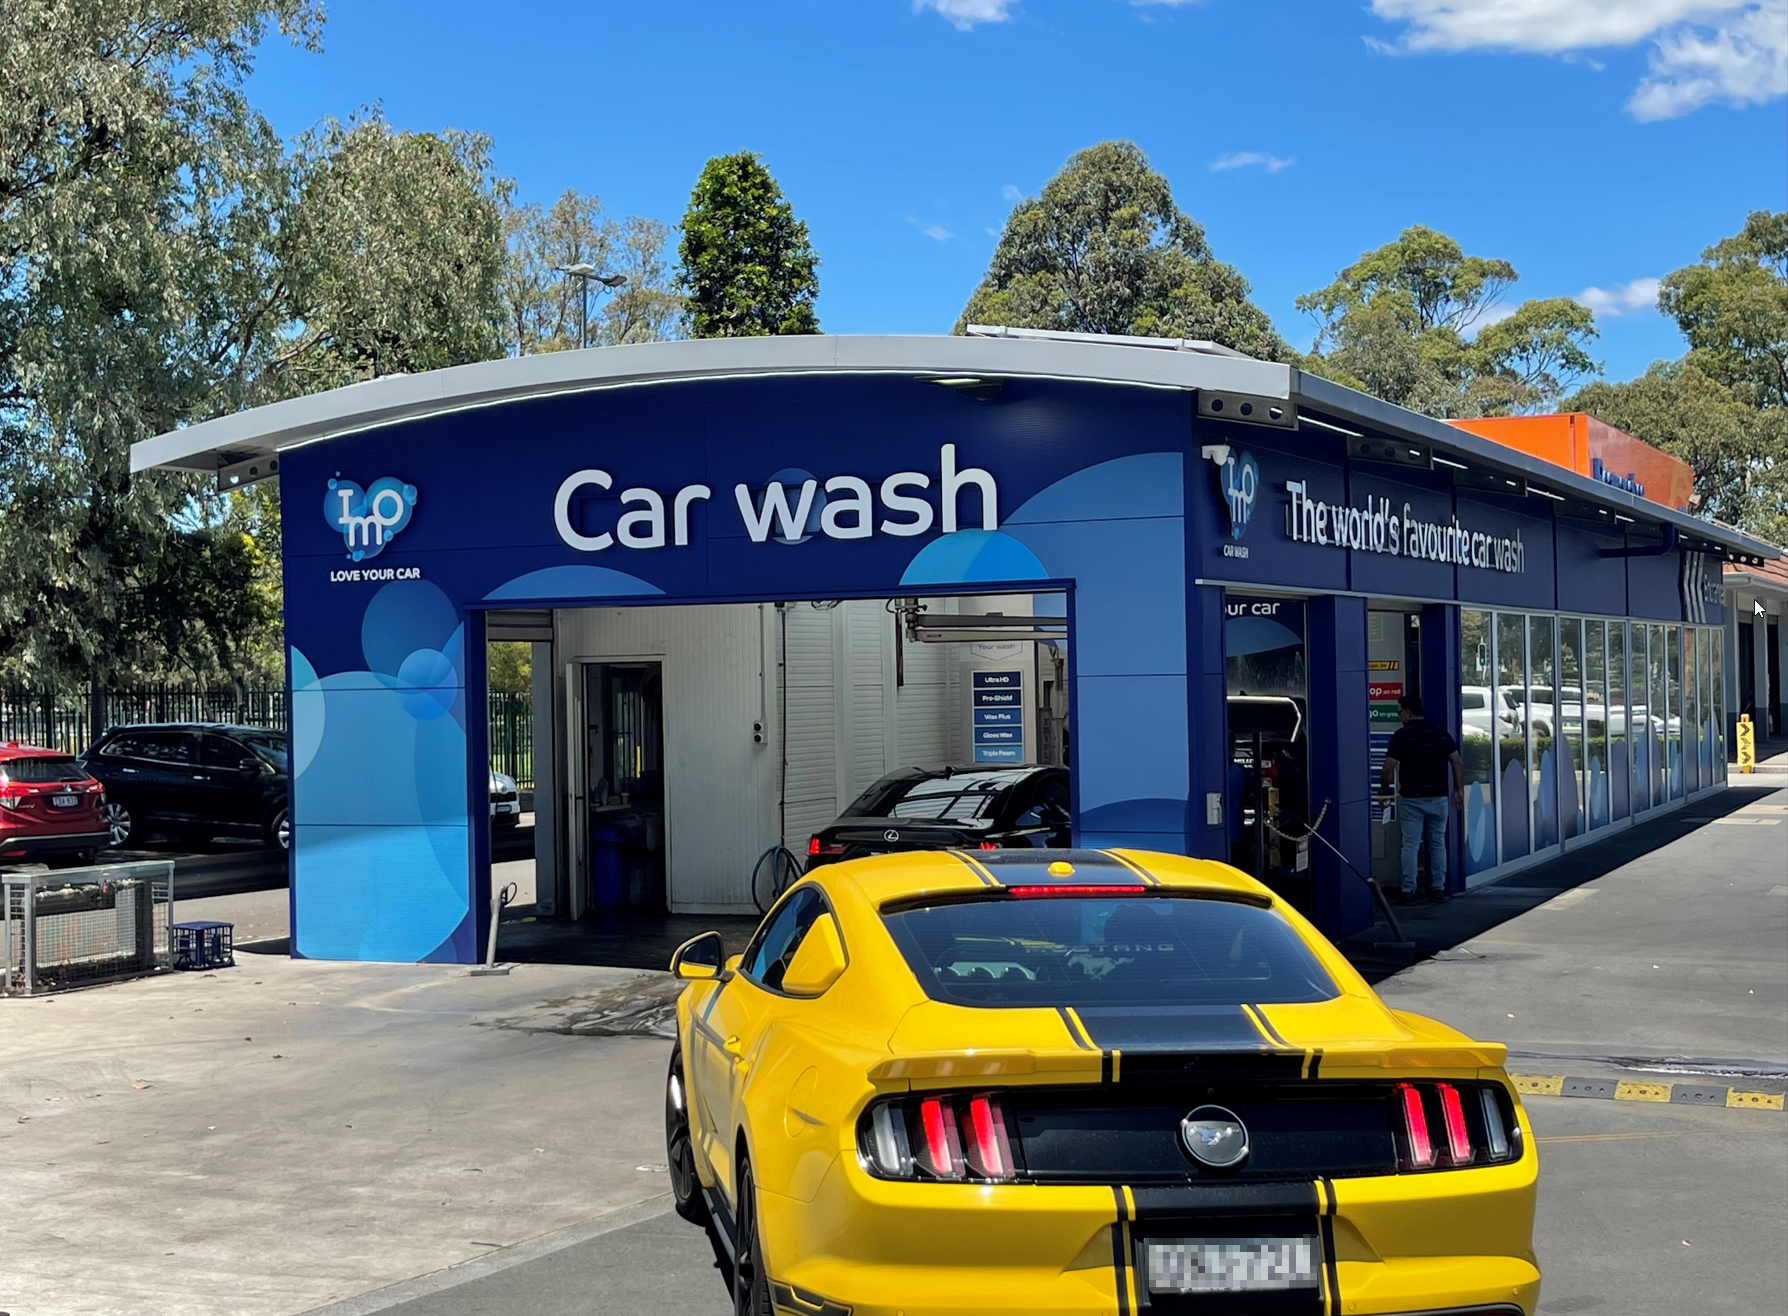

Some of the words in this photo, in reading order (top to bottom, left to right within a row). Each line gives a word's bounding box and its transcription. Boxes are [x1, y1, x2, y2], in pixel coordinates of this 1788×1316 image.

[553, 469, 711, 552] Car
[734, 443, 998, 543] wash
[1286, 478, 1328, 546] The
[1331, 493, 1400, 556] world's
[1402, 501, 1470, 567] favourite
[1471, 530, 1495, 569] car
[1494, 527, 1525, 574] wash
[1223, 544, 1234, 557] CAR
[330, 570, 360, 582] LOVE
[361, 568, 395, 581] YOUR
[396, 567, 421, 580] CAR
[1225, 603, 1247, 616] ur
[1251, 602, 1280, 615] car
[982, 694, 1013, 702] Pro-Shield
[1369, 687, 1382, 697] op
[982, 750, 998, 758] Triple
